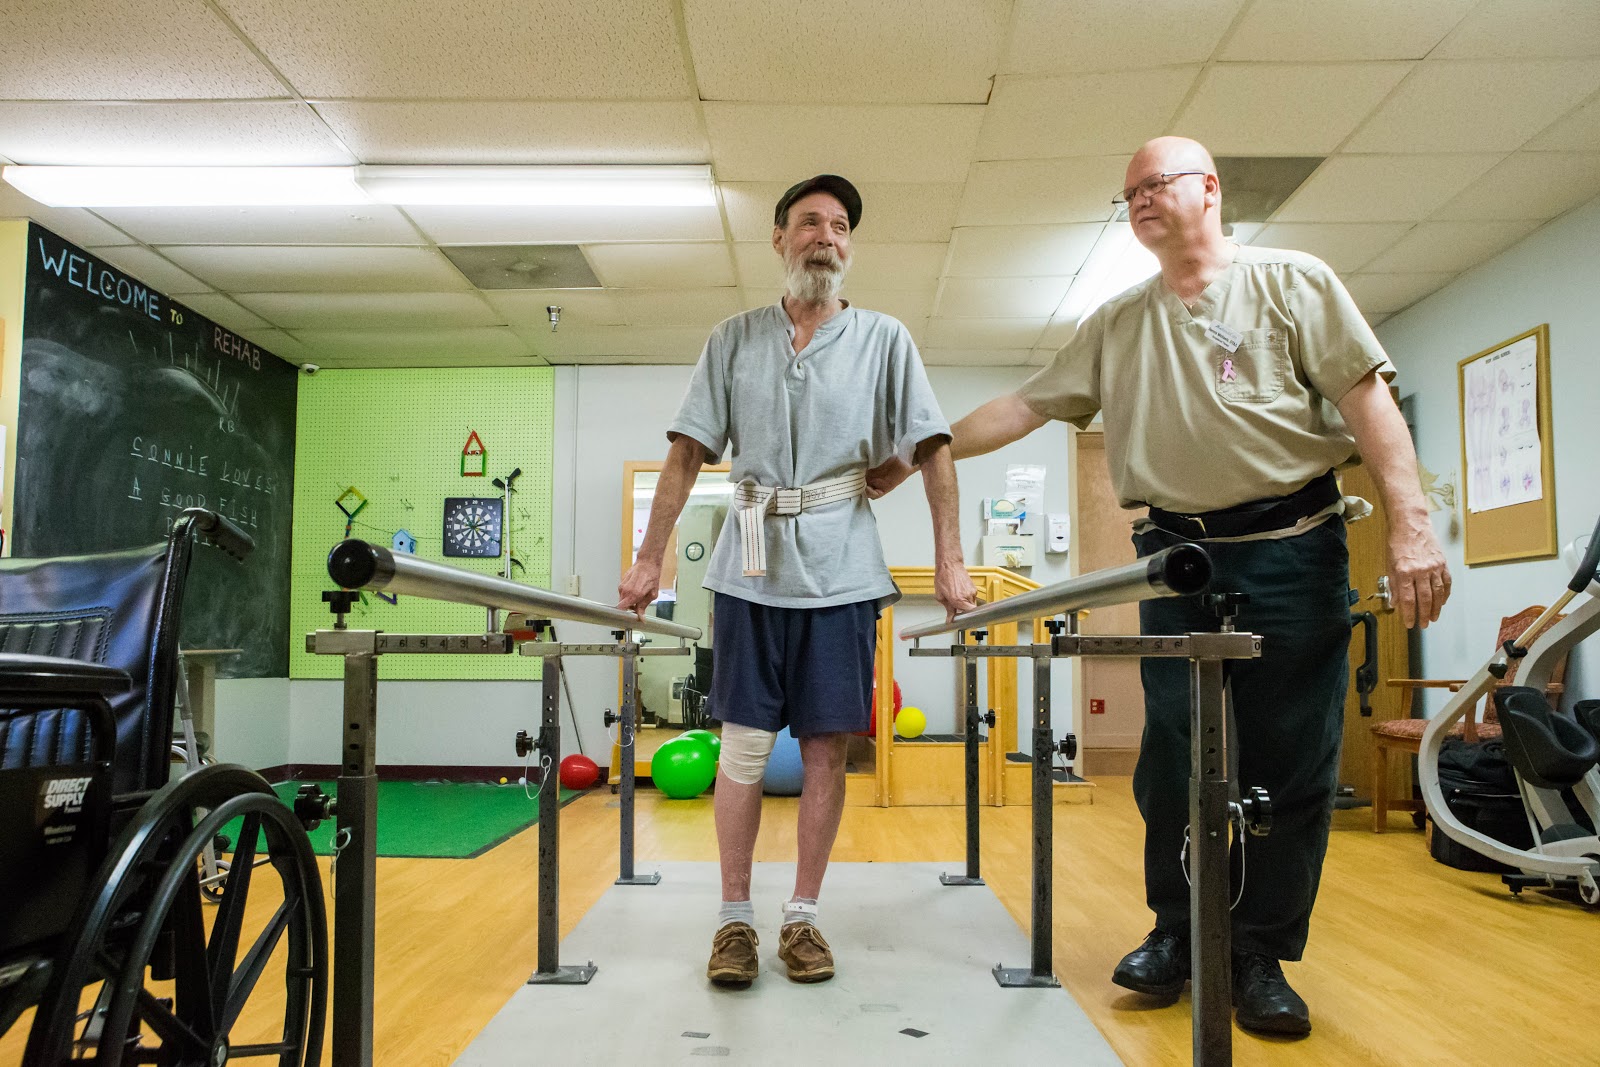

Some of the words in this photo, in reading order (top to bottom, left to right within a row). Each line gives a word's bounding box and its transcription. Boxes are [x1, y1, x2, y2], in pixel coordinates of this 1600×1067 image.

[39, 238, 161, 321] WELCOME
[170, 308, 183, 325] TO
[214, 327, 261, 371] REHAB
[133, 437, 208, 472] CONNIE
[161, 488, 206, 509] GOOD
[220, 498, 257, 526] FISH
[43, 792, 85, 809] SUPPLY
[47, 778, 92, 794] DIRECT
